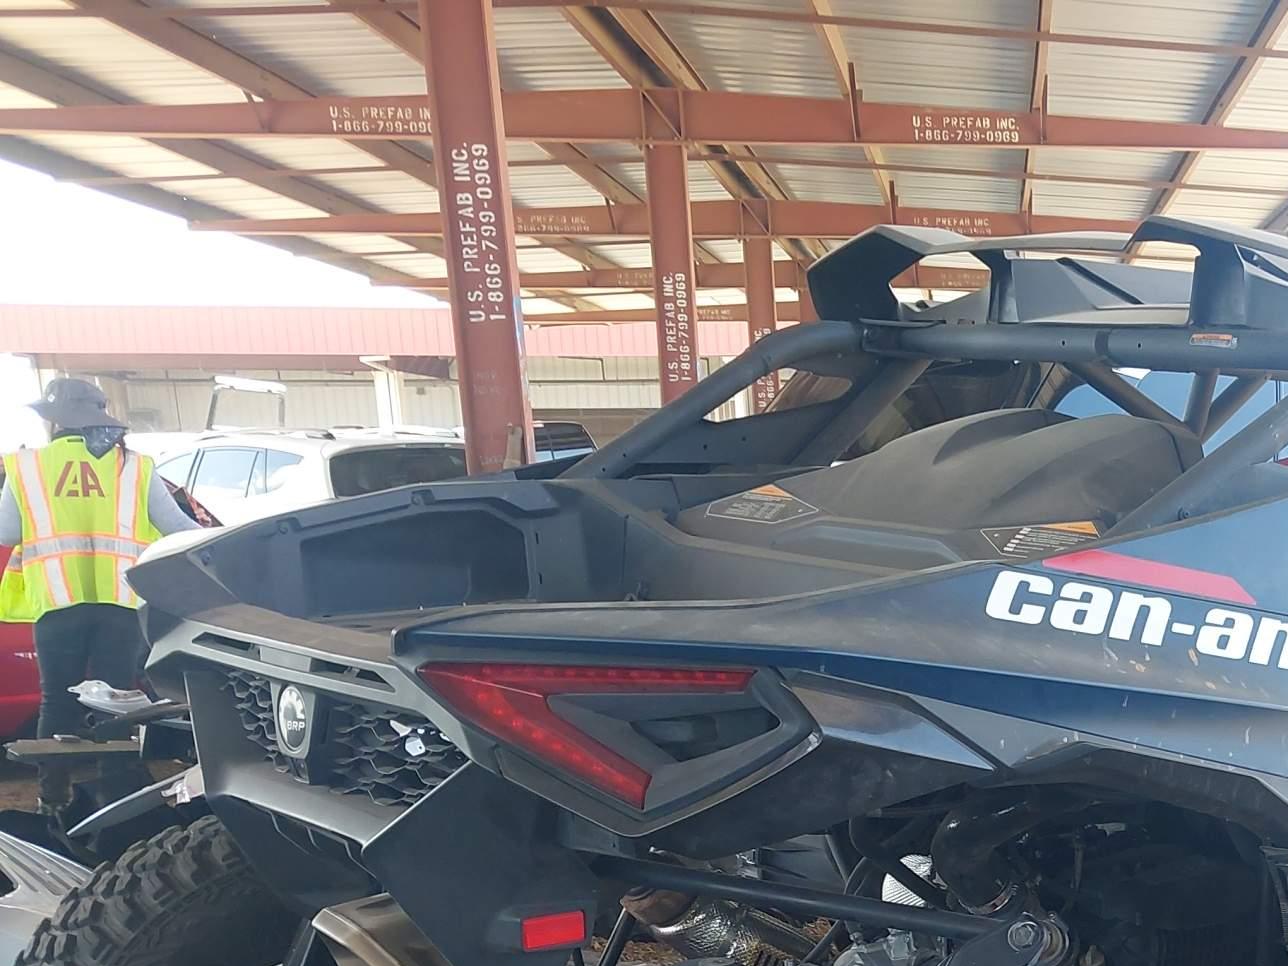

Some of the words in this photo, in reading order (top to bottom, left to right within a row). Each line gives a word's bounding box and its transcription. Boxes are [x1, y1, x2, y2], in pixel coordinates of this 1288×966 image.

[331, 119, 432, 133] 1-866-799-09
[912, 115, 937, 128] U.S.
[943, 116, 991, 129] PREFAB
[996, 117, 1020, 131] INC.
[914, 128, 1019, 143] 1-866-799-0969
[451, 141, 472, 182] INC.
[456, 192, 481, 273] PREFAB
[471, 143, 507, 321] 1-866-799-0969
[467, 283, 486, 323] U.S.
[662, 272, 675, 297] INC.
[663, 302, 679, 352] PREFAB
[674, 272, 692, 381] 1-866-799-0969
[286, 720, 305, 732] BRP
